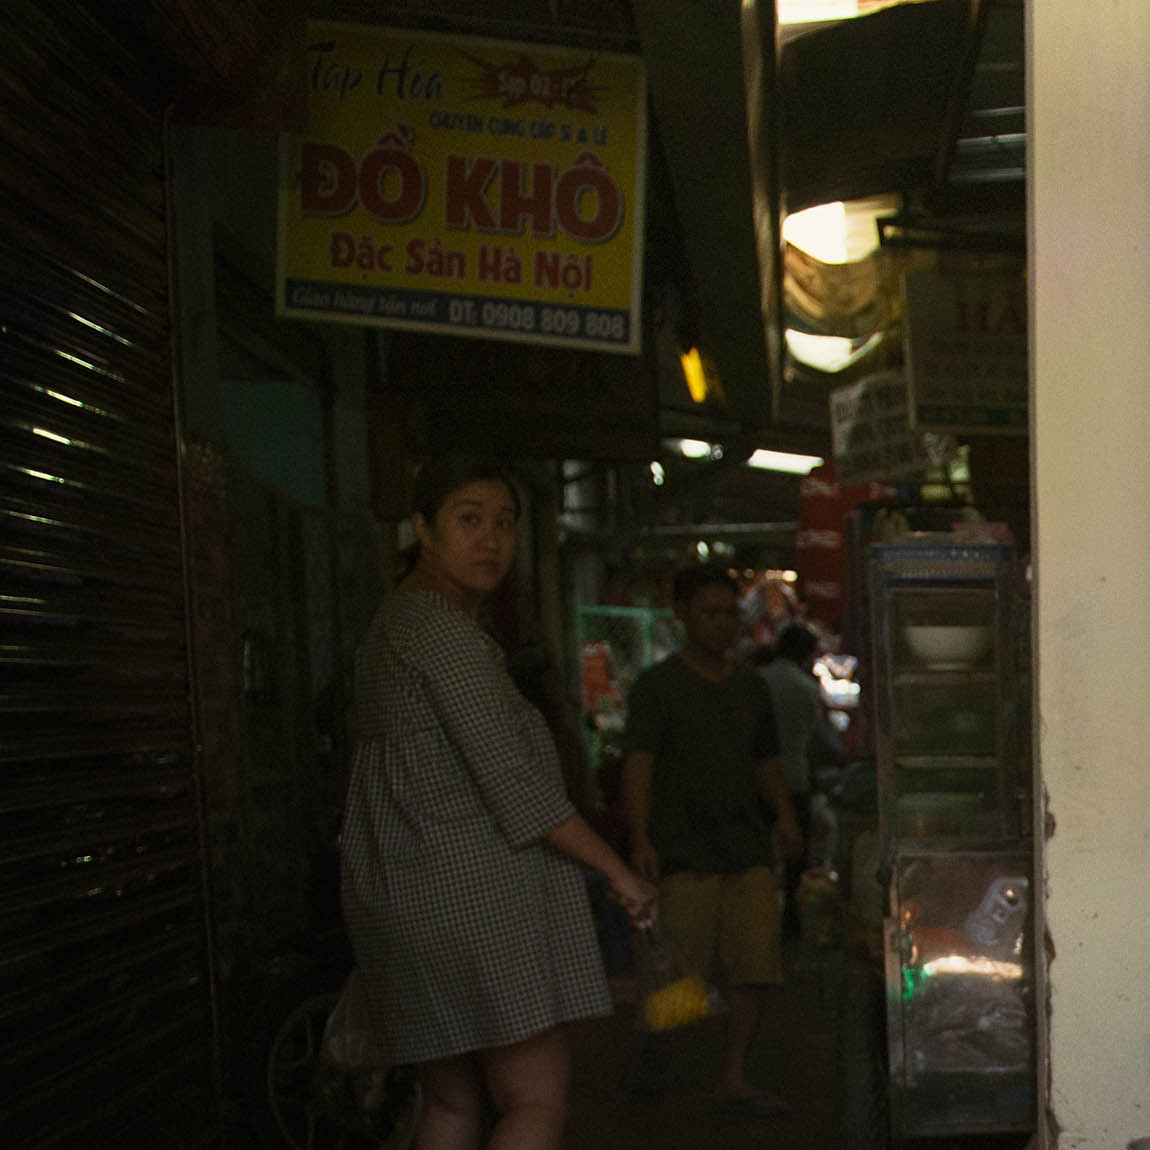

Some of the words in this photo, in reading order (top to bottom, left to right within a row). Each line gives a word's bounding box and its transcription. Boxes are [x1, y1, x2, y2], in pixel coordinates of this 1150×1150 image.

[443, 151, 624, 244] KHÔ
[330, 231, 392, 280] Đặc
[406, 236, 466, 280] Sản
[478, 245, 523, 286] Hà
[534, 250, 594, 298] Nội
